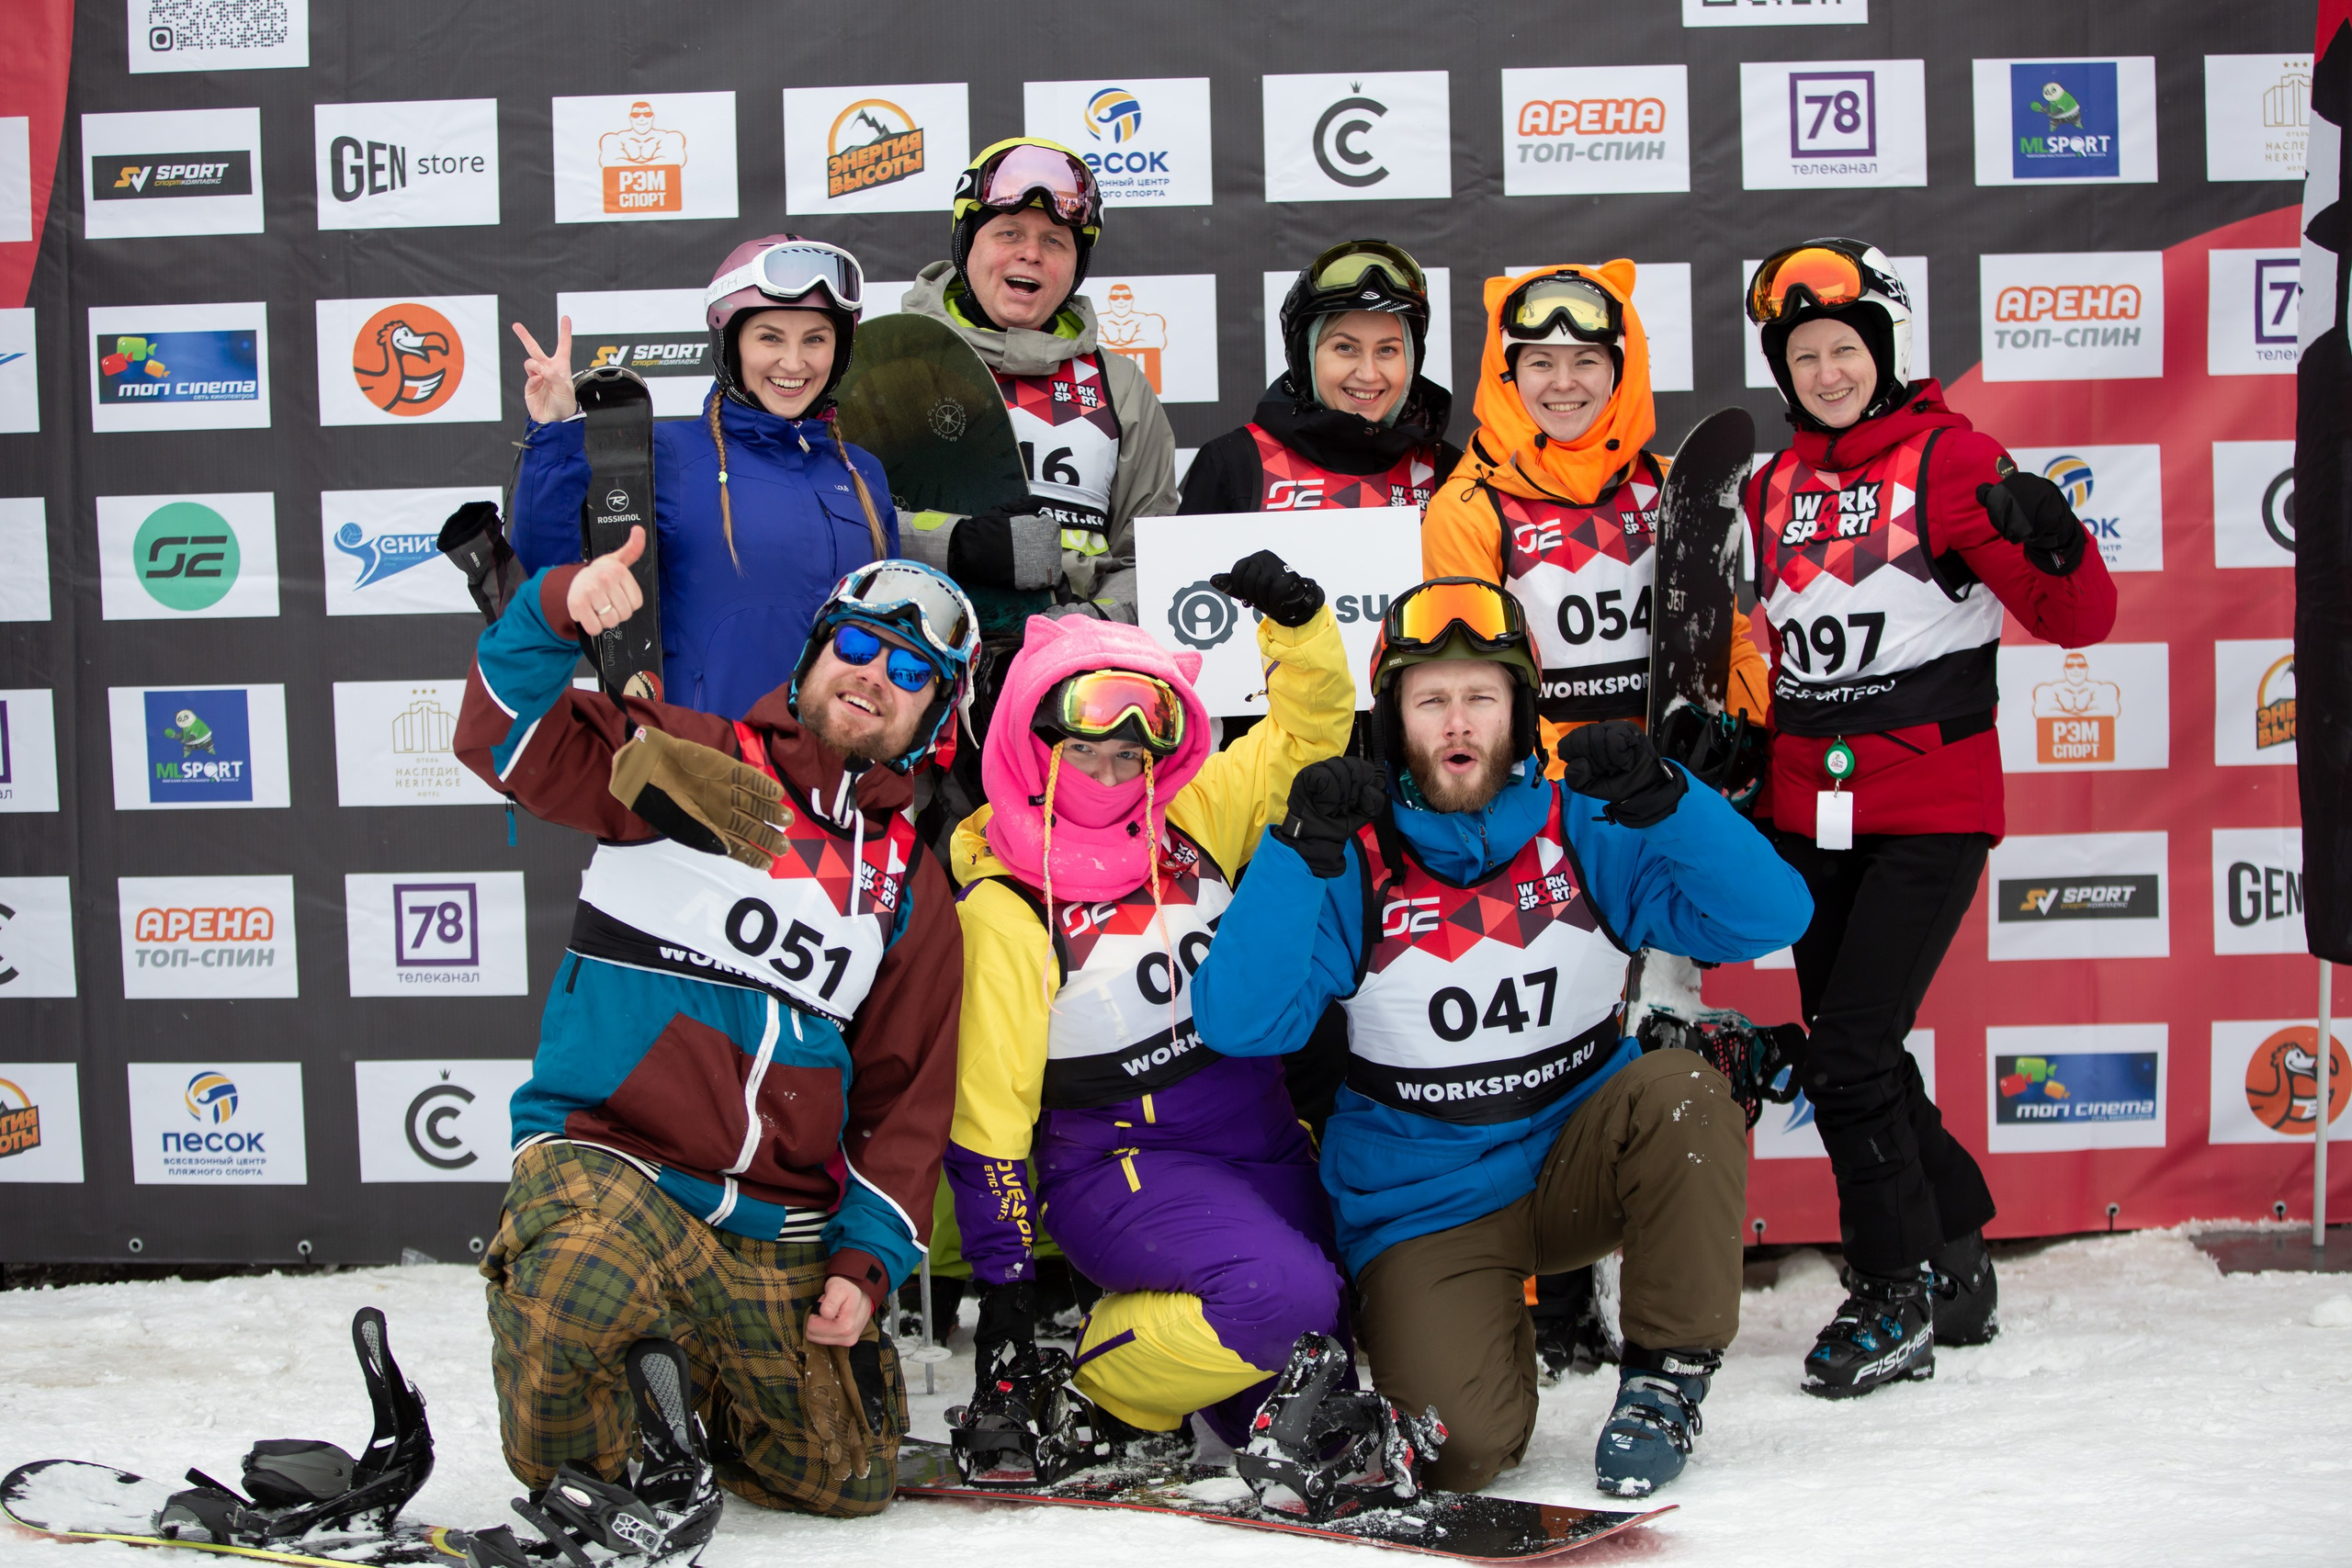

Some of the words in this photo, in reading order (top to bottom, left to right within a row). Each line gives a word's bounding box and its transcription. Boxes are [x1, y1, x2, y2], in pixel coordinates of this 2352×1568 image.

[1518, 98, 1666, 136] АРЕНА
[1804, 90, 1861, 141] 78
[829, 131, 922, 176] ЭНЕРГИЯ
[1517, 141, 1666, 163] ТОП-СПИН
[2265, 141, 2306, 151] НАСЛЕ
[2265, 152, 2303, 162] HERIT
[155, 163, 230, 180] SPORT
[331, 135, 407, 202] GEN
[417, 152, 485, 176] store
[1084, 151, 1170, 174] есок
[1792, 161, 1878, 175] телеканал
[618, 170, 666, 192] РЭМ
[830, 155, 922, 197] ВЫСОТЫ
[1137, 178, 1170, 187] ЦЕНТР
[618, 192, 666, 209] СПОРТ
[1125, 189, 1166, 198] СПОРТА
[1996, 284, 2142, 322] АРЕНА
[2267, 280, 2298, 326] 7
[1995, 327, 2142, 350] ТОП-СПИН
[633, 343, 709, 360] SPORT
[597, 513, 641, 524] ROSSIGNOL
[1667, 588, 1687, 613] JET
[1557, 585, 1651, 646] 054
[1783, 610, 1886, 677] 097
[2052, 721, 2099, 743] РЭМ
[2052, 743, 2099, 759] СПОРТ
[395, 767, 459, 777] НАСЛЕДИЕ
[395, 778, 461, 788] HERITAGE
[2062, 886, 2137, 904] SPORT
[136, 907, 275, 942] АРЕНА
[409, 901, 464, 950] 78
[135, 948, 276, 968] ТОП-СПИН
[725, 897, 852, 1001] 051
[397, 972, 480, 984] телеканал
[1428, 967, 1558, 1043] 047
[1396, 1040, 1596, 1102] WORKSPORT.RU
[162, 1133, 265, 1153] песок
[164, 1157, 232, 1166] ВСЕСЕЗОННЫЙ
[236, 1157, 266, 1166] ЦЕНТР
[225, 1168, 263, 1177] СПОРТА
[1852, 1320, 1934, 1385] FISCHER
